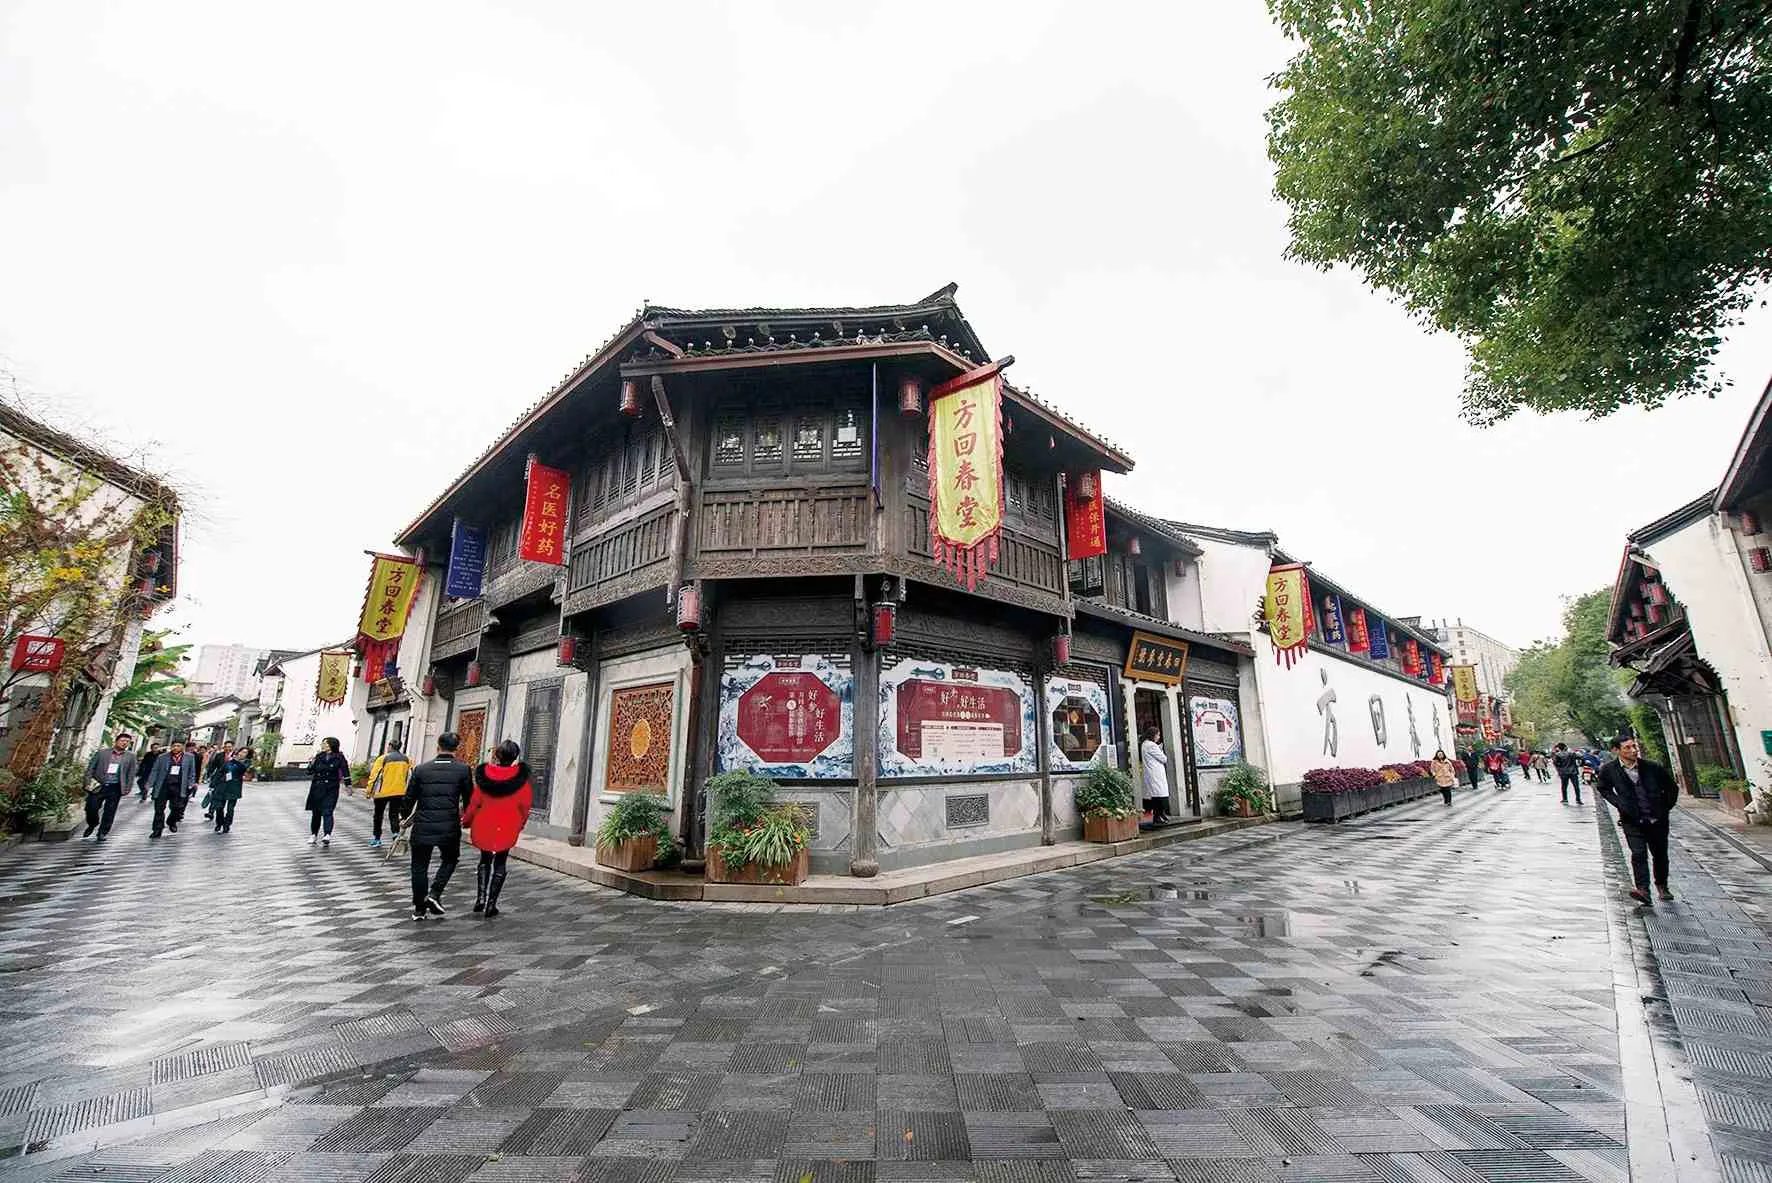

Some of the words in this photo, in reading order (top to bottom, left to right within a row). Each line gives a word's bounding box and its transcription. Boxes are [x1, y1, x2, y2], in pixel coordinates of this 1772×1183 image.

[953, 400, 980, 529] 方回春堂
[536, 484, 561, 556] 名医好药
[376, 567, 406, 634] 方回春堂
[1274, 577, 1292, 640] 方回春堂
